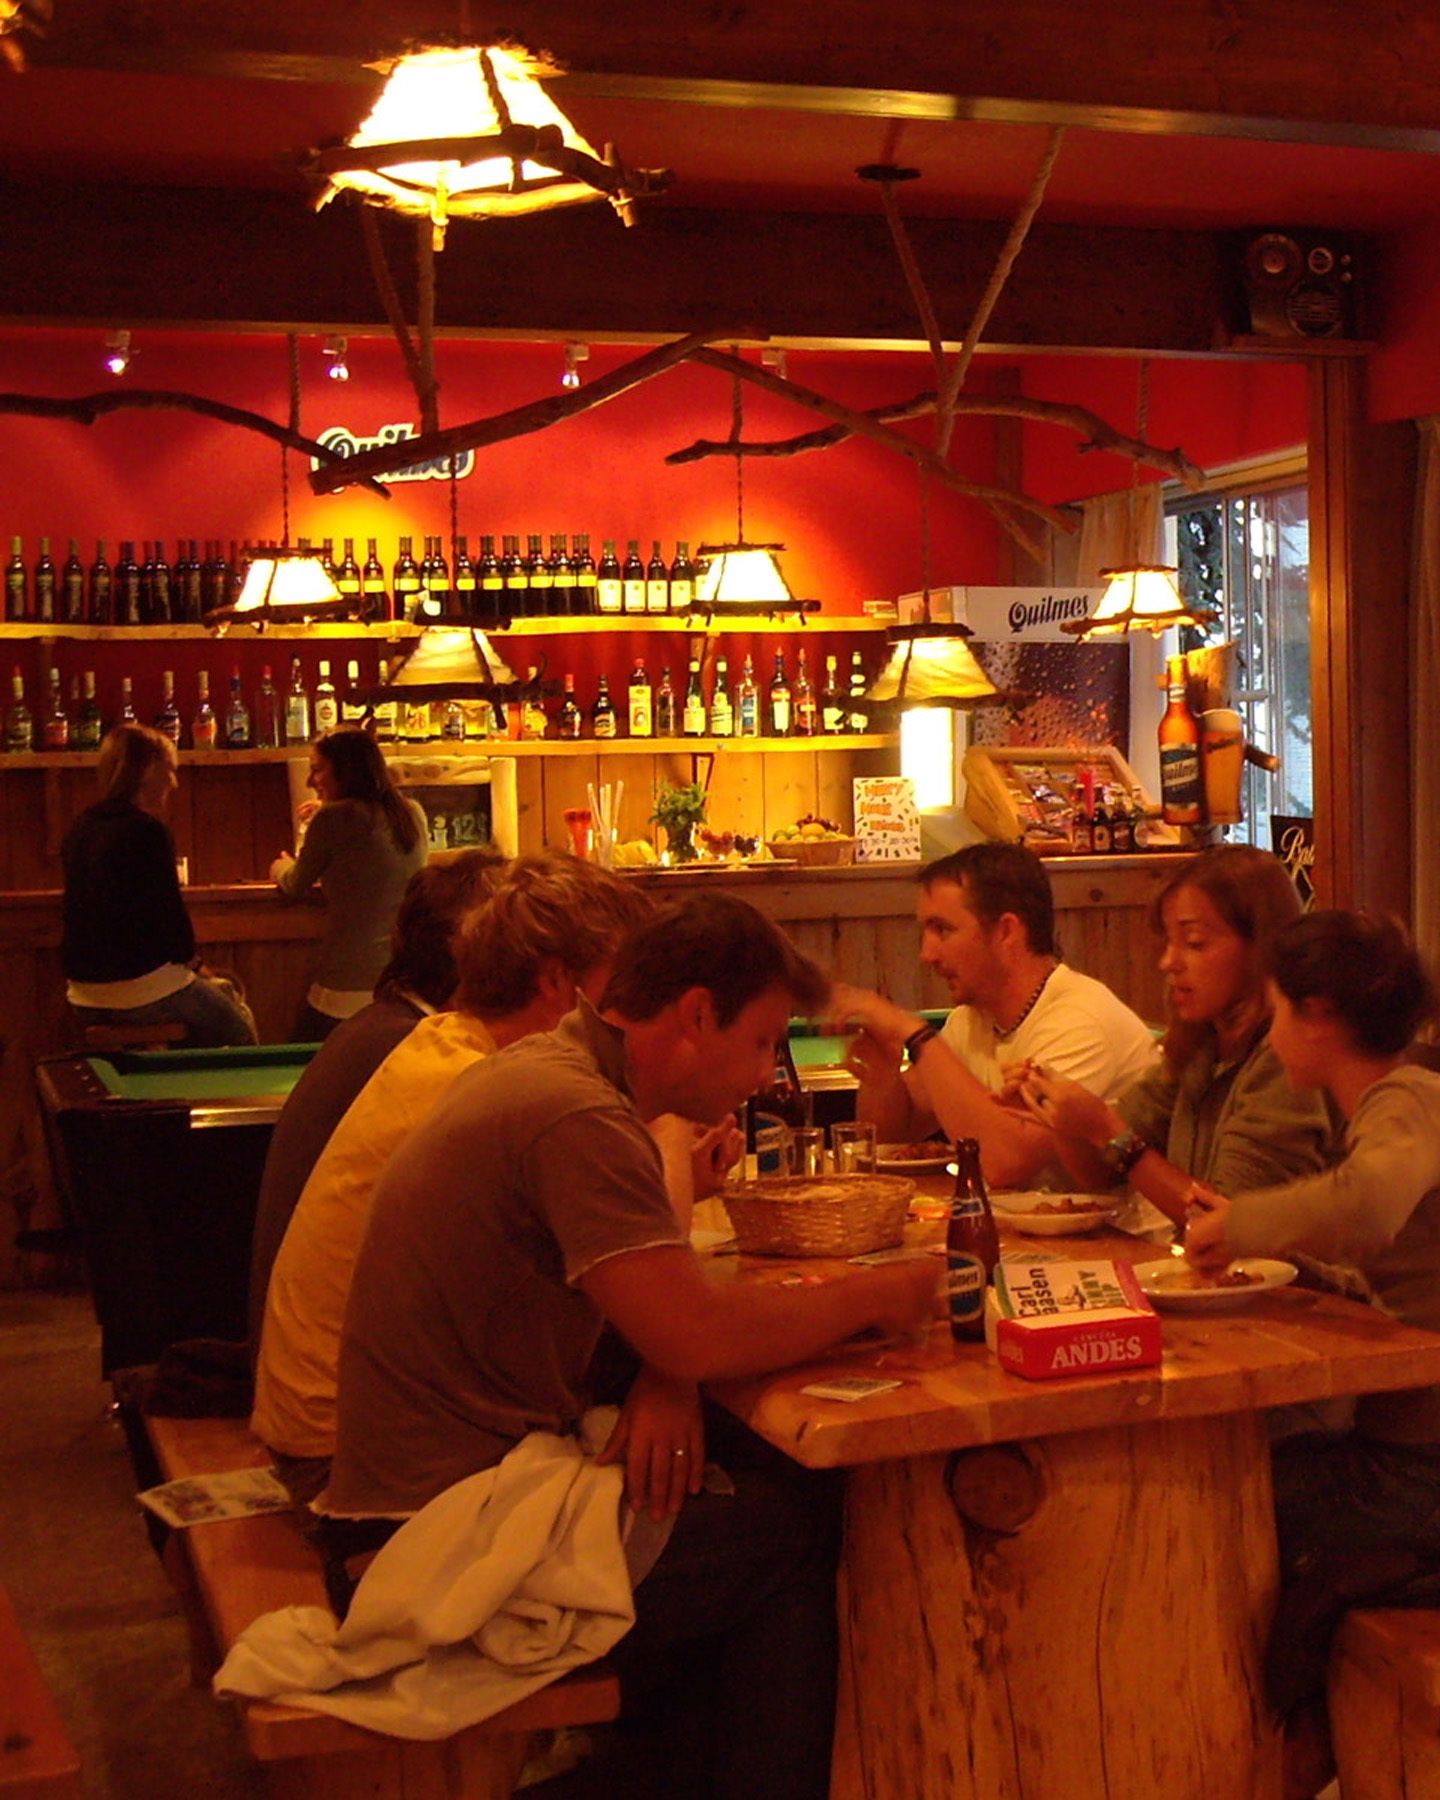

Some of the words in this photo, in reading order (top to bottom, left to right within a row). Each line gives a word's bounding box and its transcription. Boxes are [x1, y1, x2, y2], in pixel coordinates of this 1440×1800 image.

[1008, 595, 1088, 634] Quilmes
[1010, 1285, 1042, 1318] Carl
[1029, 1267, 1060, 1316] aasen
[1051, 1336, 1143, 1370] ANDES
